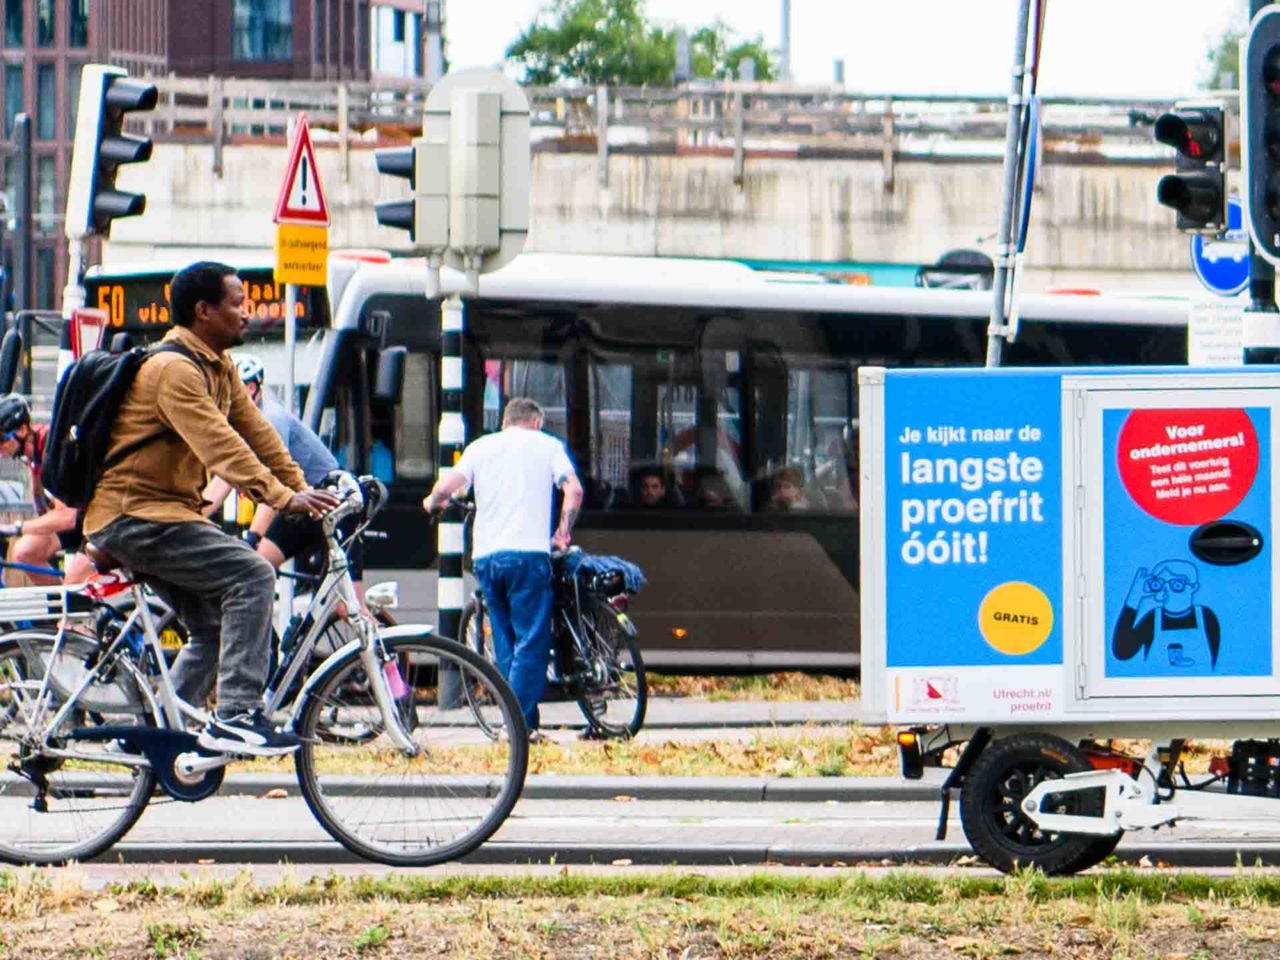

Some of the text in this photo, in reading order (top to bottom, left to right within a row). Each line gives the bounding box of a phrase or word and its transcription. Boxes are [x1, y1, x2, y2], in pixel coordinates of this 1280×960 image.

[138, 302, 169, 323] via
[899, 424, 1042, 447] Je kijkt naar de
[1165, 425, 1205, 440] Voor
[1129, 432, 1245, 460] ondernemers!
[901, 451, 1044, 490] langste
[1150, 456, 1230, 475] Test dit voertuig
[1150, 478, 1170, 488] een
[1155, 488, 1180, 500] Meld
[1181, 486, 1192, 498] je
[1193, 485, 1207, 495] nu
[901, 490, 1044, 533] proefrit
[901, 530, 988, 565] óóit!
[993, 611, 1039, 626] GRATIS
[1010, 700, 1053, 715] proefrit
